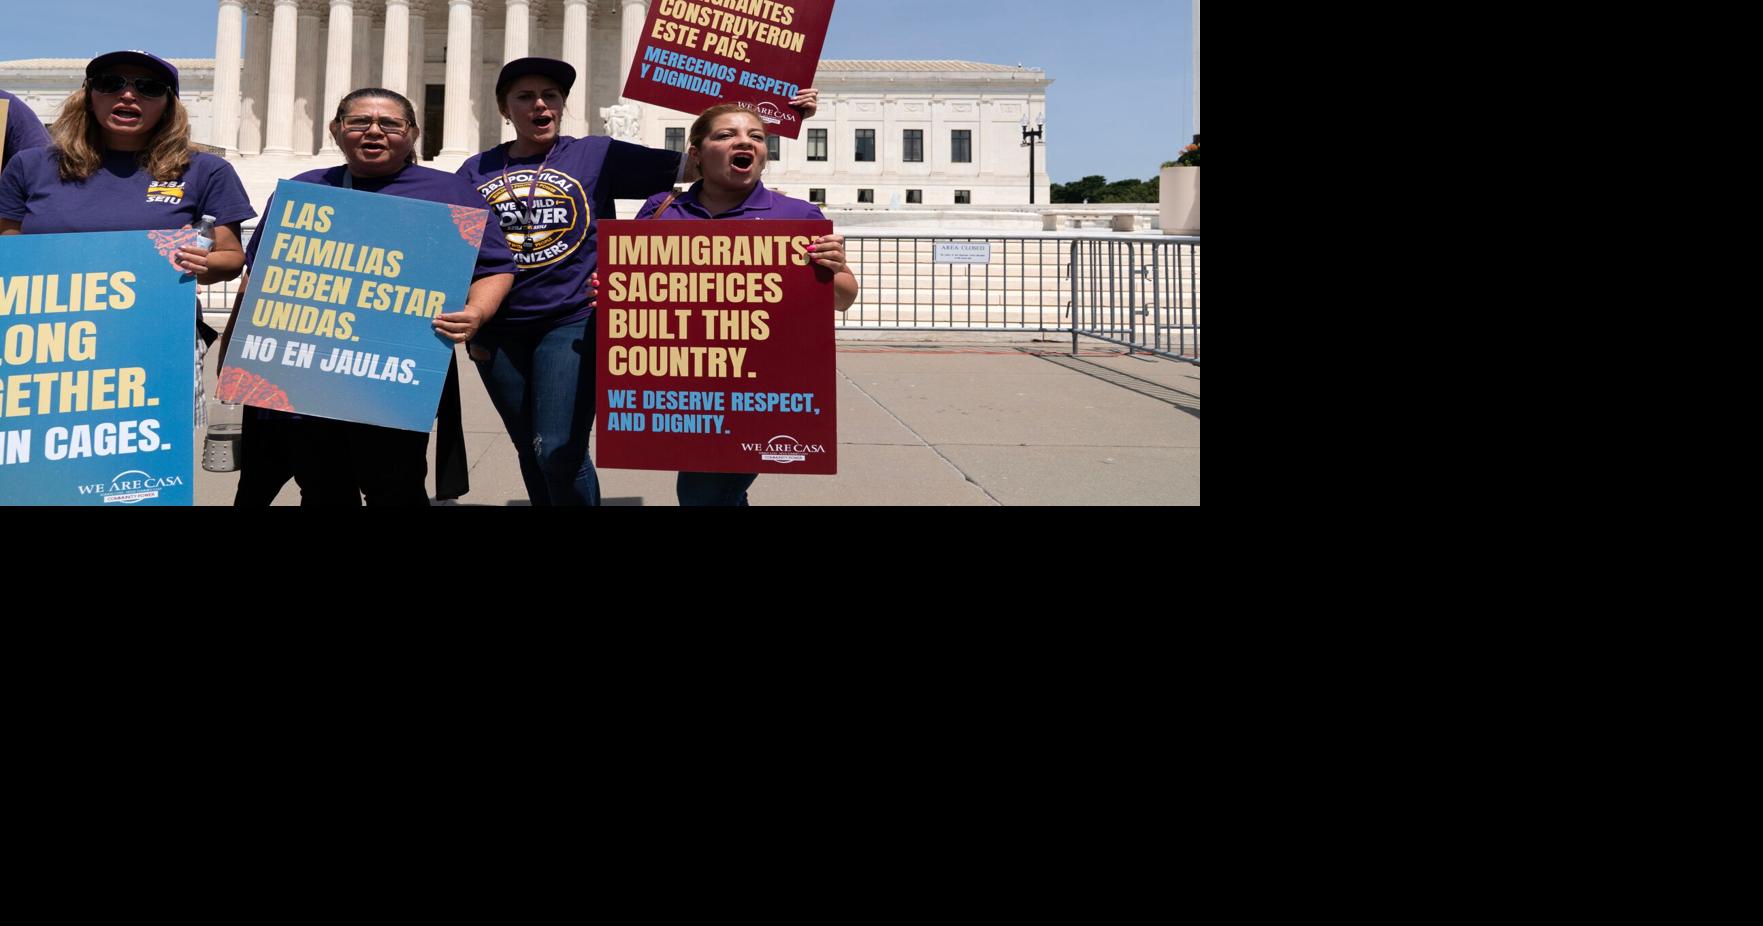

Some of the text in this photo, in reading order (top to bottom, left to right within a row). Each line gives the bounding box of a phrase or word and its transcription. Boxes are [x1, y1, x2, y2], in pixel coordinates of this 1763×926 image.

[659, 0, 805, 53] CONSTRUYERON
[703, 0, 795, 26] RANTES
[651, 18, 751, 63] ESTE PAÍS.
[644, 46, 737, 83] MERECEMOS
[640, 63, 724, 99] Y DIGNIDAD.
[754, 106, 773, 116] ARE
[773, 111, 796, 122] CASA
[146, 195, 182, 205] SEIU
[481, 179, 504, 199] 2BJ
[508, 173, 574, 193] POLTICAL
[280, 200, 335, 233] LAS
[496, 202, 516, 212] WE
[499, 207, 569, 227] OWER
[271, 233, 404, 278] FAMILIAS
[261, 266, 446, 319] DEBEN ESTAR
[608, 272, 783, 303] SACRIFICES
[252, 299, 360, 342] UNIDAS.
[608, 309, 770, 341] BUILT THIS
[0, 320, 97, 367] ONG
[241, 334, 420, 385] NO EN JAULAS.
[608, 346, 757, 378] COUNTRY.
[0, 366, 160, 418] ETHER.
[608, 389, 820, 415] WE DESERVE RESPECT,
[44, 418, 171, 461] CAGES.
[607, 413, 731, 435] AND DIGNITY.
[741, 443, 825, 453] WE ARE CASA
[78, 483, 104, 494] WE
[109, 480, 141, 492] ARE
[144, 475, 183, 489] CASA
